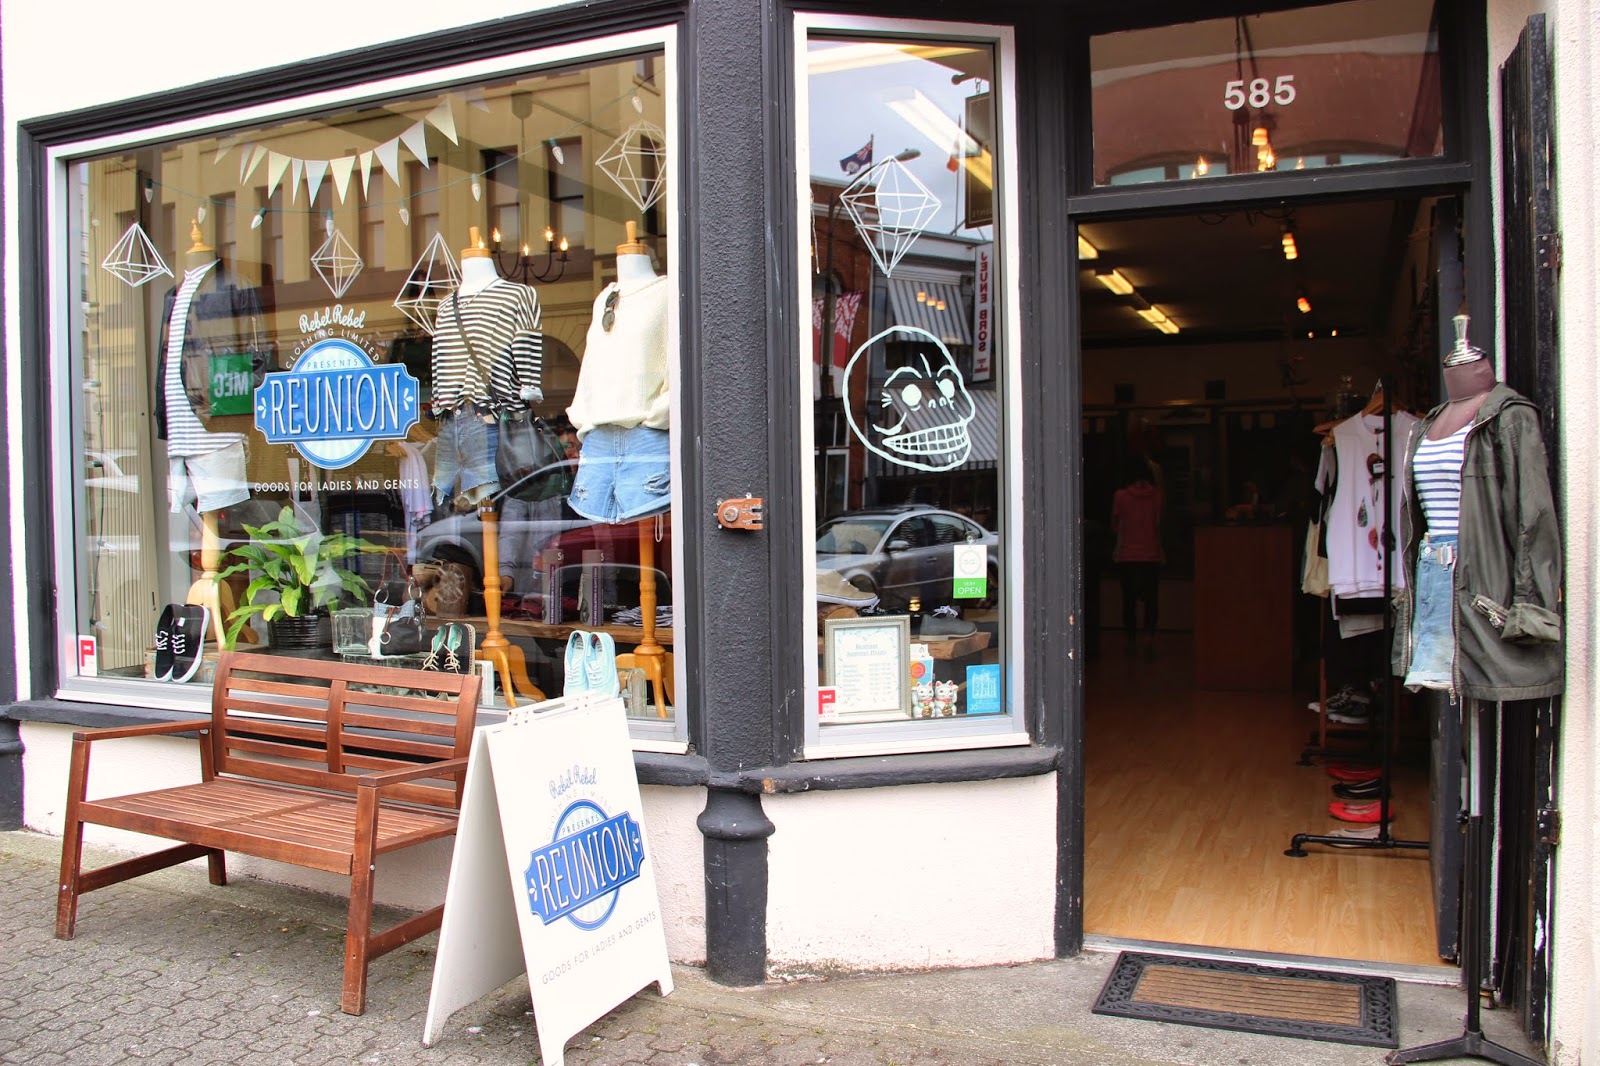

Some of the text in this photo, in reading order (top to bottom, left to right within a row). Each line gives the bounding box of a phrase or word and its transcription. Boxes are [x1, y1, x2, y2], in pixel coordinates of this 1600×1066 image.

[1224, 75, 1296, 110] 585
[299, 304, 366, 334] Rebel Rebel
[285, 329, 380, 369] CLOTHING LIMITED
[307, 359, 358, 369] PRESENTS
[270, 371, 400, 435] REUNION
[254, 478, 419, 493] GOODS FOR LADIES AND GENTS
[957, 586, 982, 595] OPEN
[549, 764, 597, 799] Rebel Rebel
[562, 814, 600, 835] PRESENTS
[535, 817, 636, 916] REUNION
[542, 910, 657, 985] GOODS FOR LADIES AND GENTS
